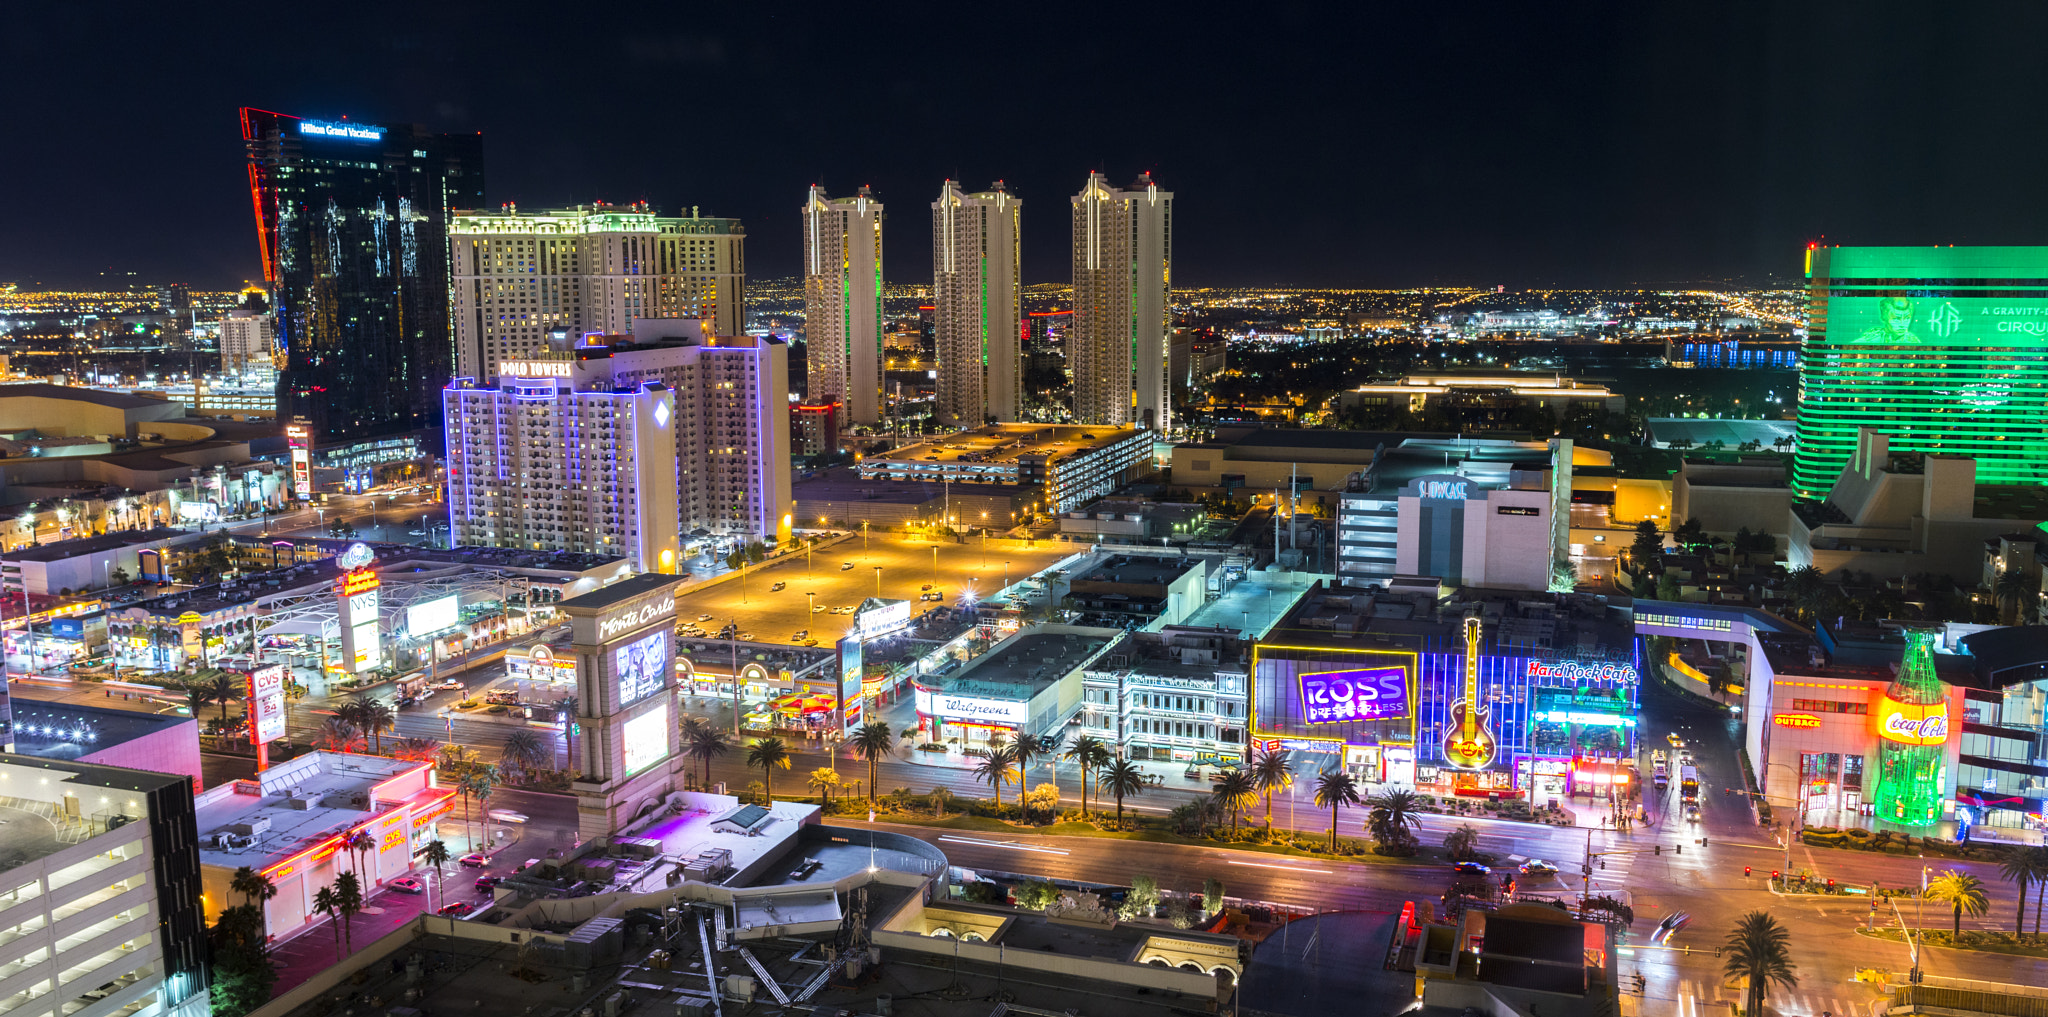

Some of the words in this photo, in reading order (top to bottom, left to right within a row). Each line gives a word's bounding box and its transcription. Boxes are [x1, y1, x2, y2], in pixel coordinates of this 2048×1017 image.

[301, 123, 325, 135] Hilton
[326, 126, 347, 137] Grand
[348, 128, 380, 140] Vacations
[1981, 307, 1989, 315] A
[1997, 321, 2048, 336] CIRQU
[501, 362, 527, 376] POLO
[529, 363, 572, 377] TOWERS
[1419, 480, 1467, 500] SHOWCASE
[351, 593, 376, 612] NYS
[599, 610, 639, 640] Monte
[638, 597, 675, 624] Carlo
[1528, 661, 1566, 677] Hard
[1566, 660, 1604, 682] Rock
[1601, 660, 1637, 683] Cafe
[258, 673, 279, 688] CVS
[1168, 679, 1213, 690] WOLLENSKY
[1306, 675, 1402, 705] ROSS
[264, 703, 277, 714] 24
[945, 699, 1011, 716] Walgreens
[1774, 717, 1821, 728] OUTBACK
[1885, 712, 1948, 739] Coca-Cola
[385, 829, 401, 843] CVS
[380, 836, 406, 855] pharmacy
[311, 846, 335, 862] Souvenirs
[277, 866, 294, 879] Photo
